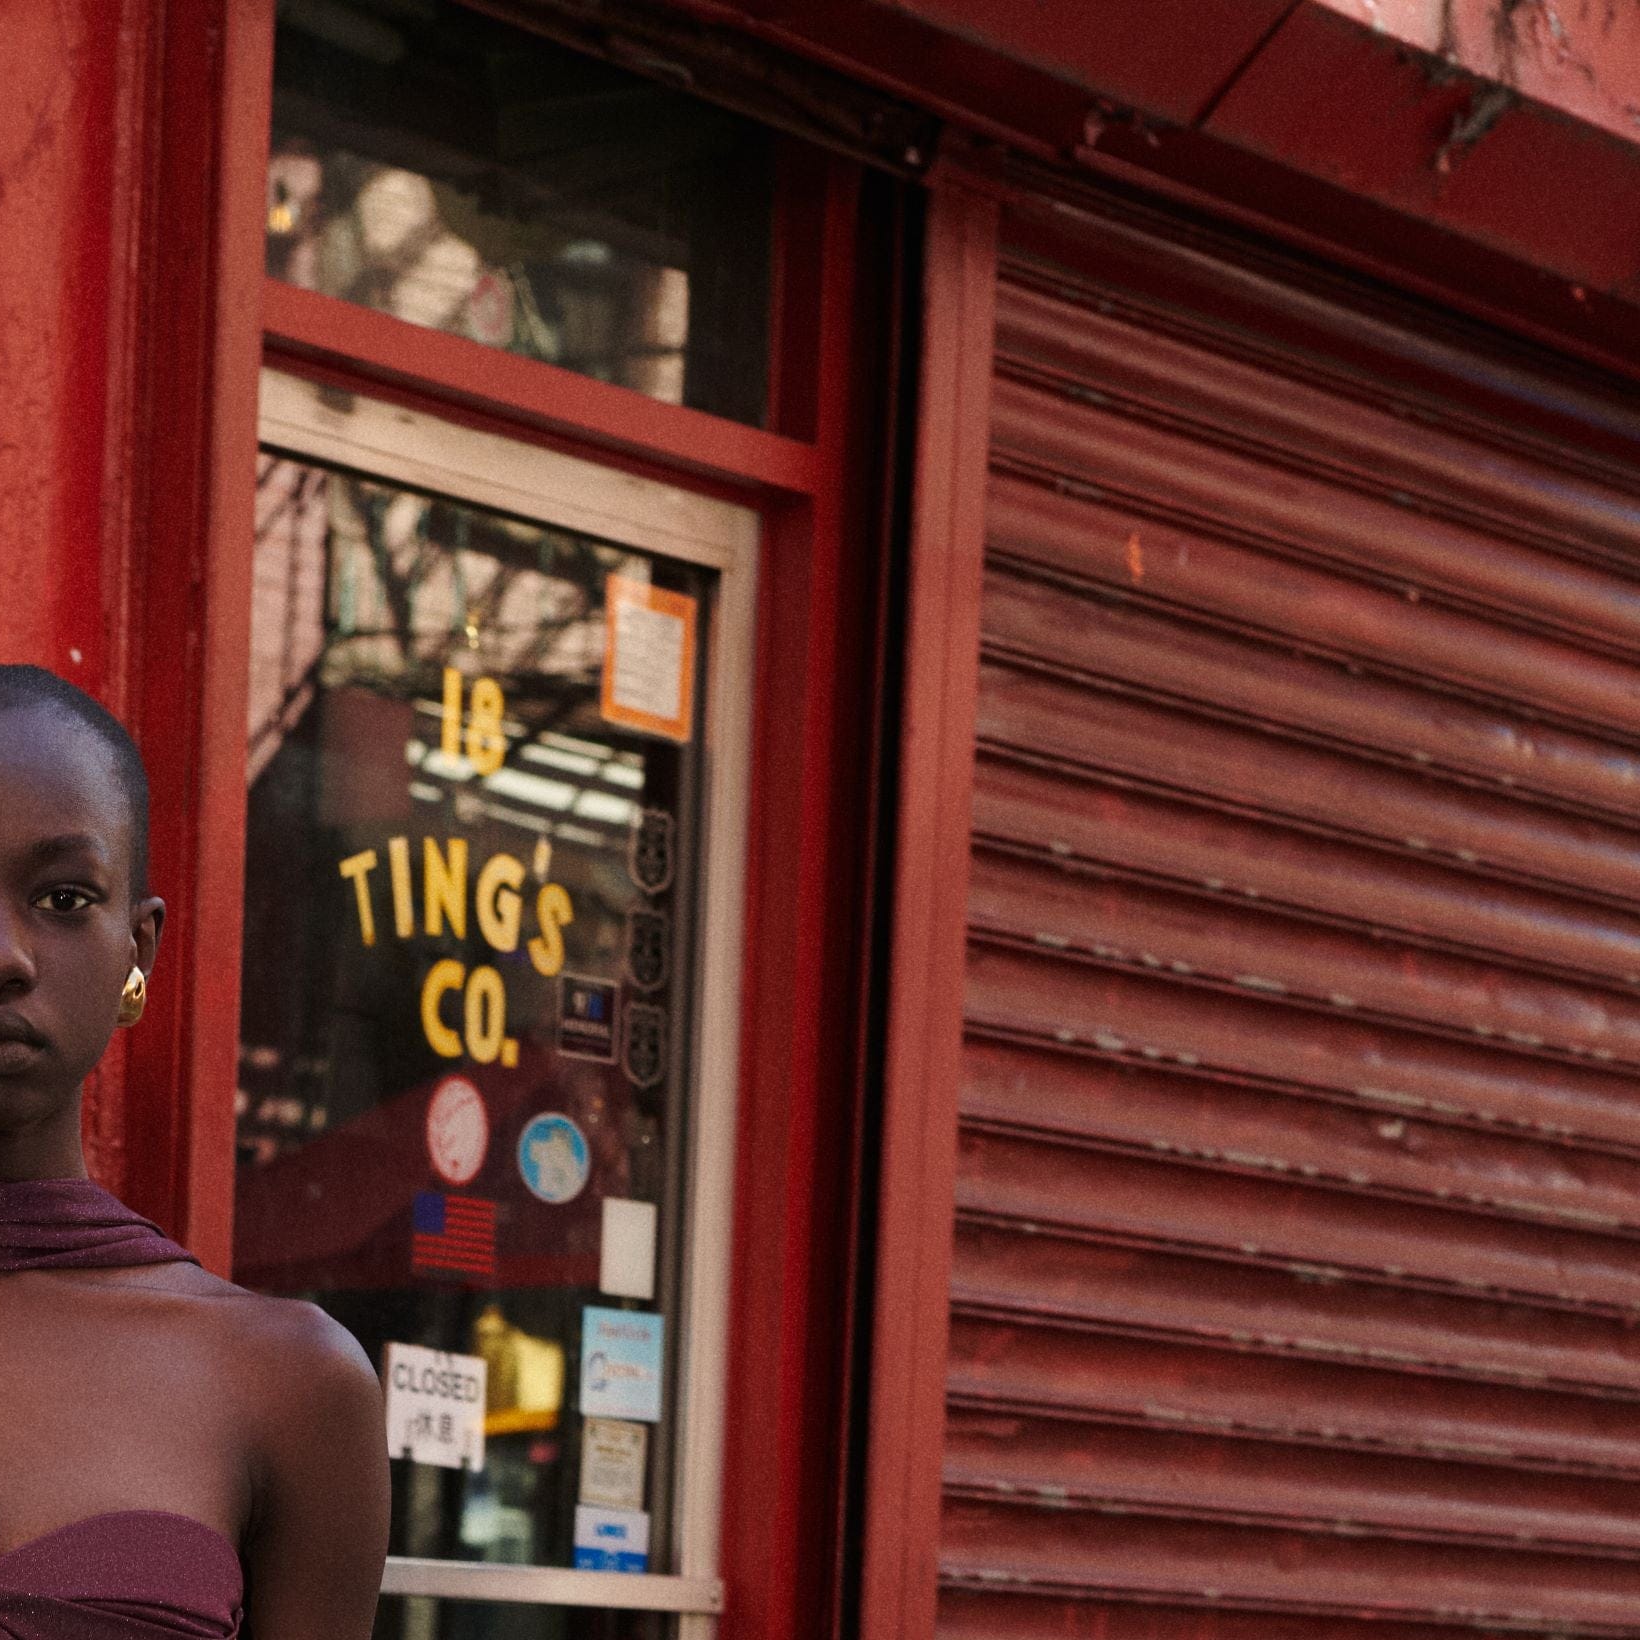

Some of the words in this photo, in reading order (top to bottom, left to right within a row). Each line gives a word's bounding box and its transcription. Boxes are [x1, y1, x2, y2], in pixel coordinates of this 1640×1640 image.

[441, 667, 506, 776] 18
[339, 836, 574, 977] TING'S
[420, 959, 518, 1069] CO.
[393, 1363, 479, 1403] CLOSED
